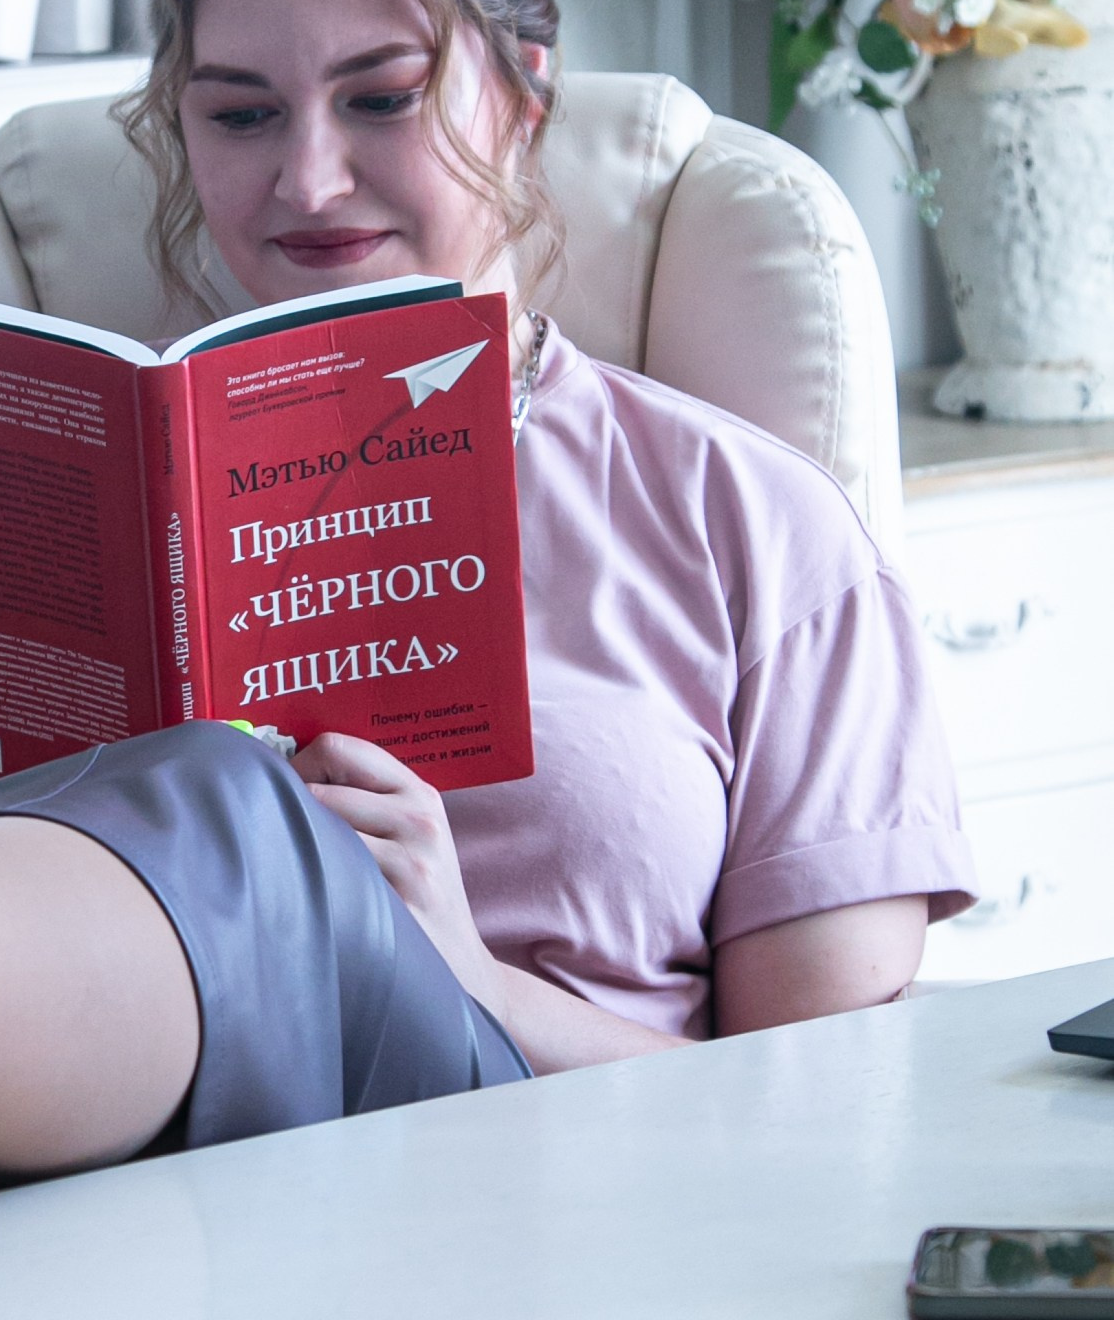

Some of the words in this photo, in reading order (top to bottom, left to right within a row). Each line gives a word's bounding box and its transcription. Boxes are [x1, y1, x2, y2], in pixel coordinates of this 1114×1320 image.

[227, 376, 241, 386] Эта
[242, 370, 266, 382] книга
[267, 362, 299, 376] бросает
[300, 358, 317, 368] нам
[318, 352, 345, 363] вызов:
[227, 383, 266, 398] способны
[267, 380, 277, 388] ли
[279, 377, 291, 385] мы
[293, 371, 314, 381] стать
[316, 367, 332, 376] еще
[334, 357, 365, 373] лучше?
[226, 449, 348, 498] Мэтью
[359, 426, 472, 466] Сайед
[167, 512, 185, 584] ЯЩИКА»
[229, 496, 433, 565] Принцип
[228, 554, 486, 632] «ЧЁРНОГО
[170, 588, 190, 674] «ЧЁРНОГО
[239, 635, 459, 706] ЯЩИКА»
[182, 682, 194, 720] нцип
[371, 711, 420, 726] Почему
[424, 703, 474, 719] ошибки
[376, 736, 408, 746] аших
[412, 722, 490, 744] достижений
[399, 753, 436, 764] знесе
[440, 750, 447, 760] и
[451, 745, 492, 757] жизни
